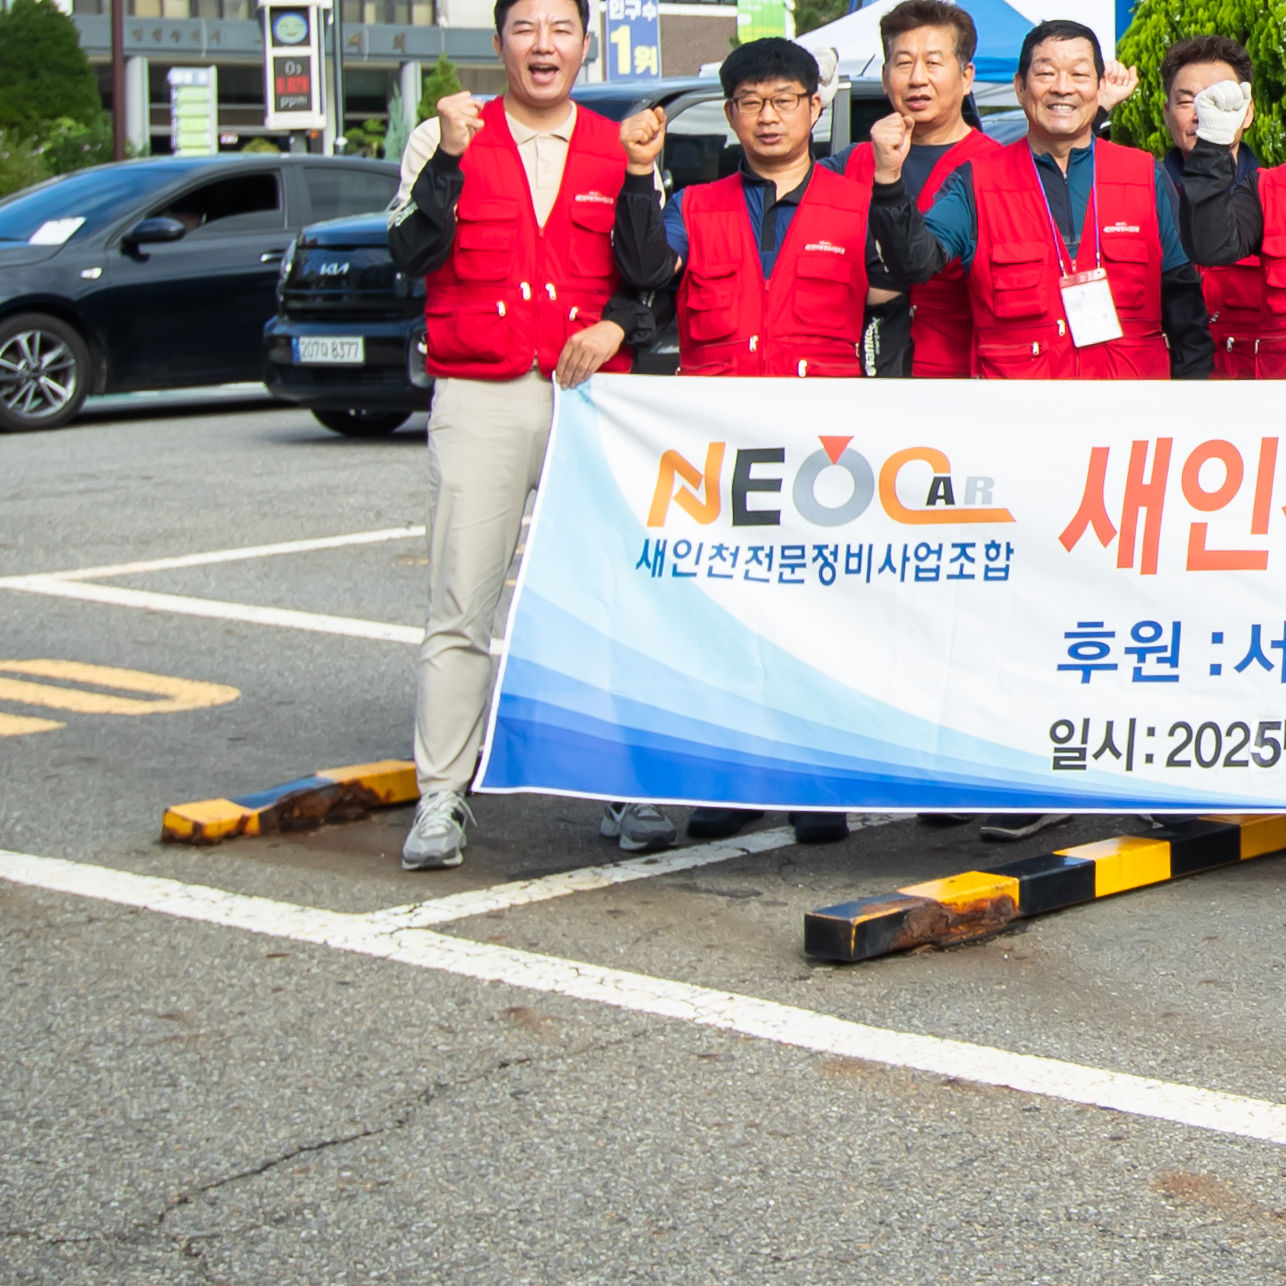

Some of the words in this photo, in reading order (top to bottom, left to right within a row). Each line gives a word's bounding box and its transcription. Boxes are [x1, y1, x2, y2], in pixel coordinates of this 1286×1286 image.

[610, 25, 658, 75] 1위
[635, 538, 1015, 587] 새인천전문정비사업조합
[1057, 620, 1181, 684] 후원
